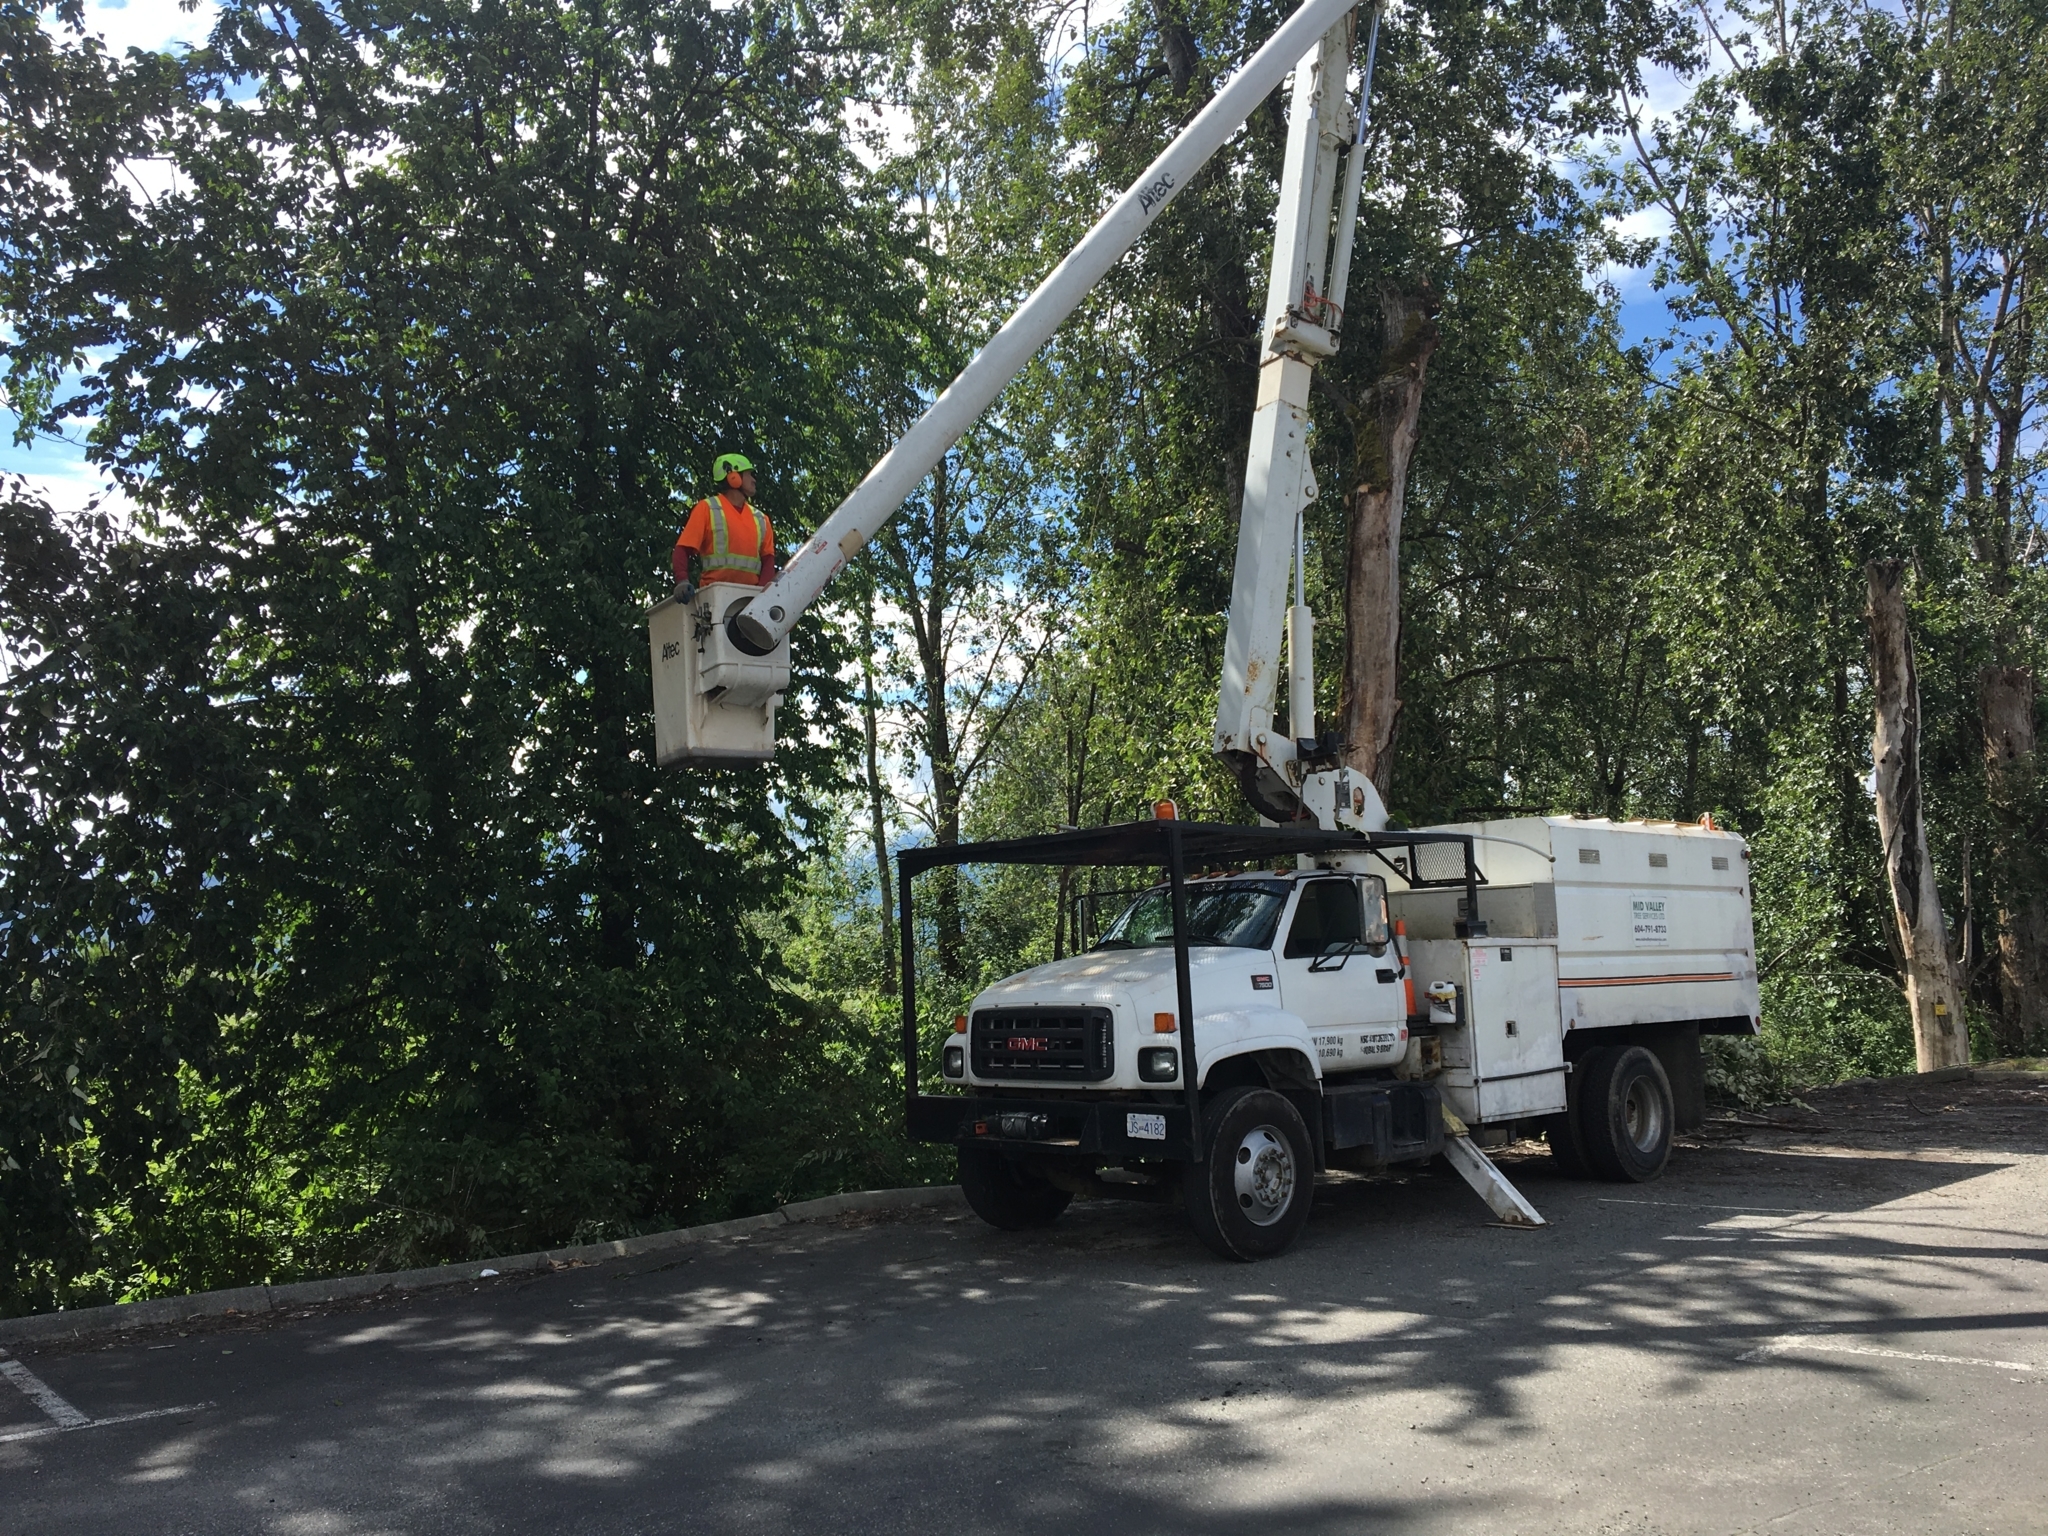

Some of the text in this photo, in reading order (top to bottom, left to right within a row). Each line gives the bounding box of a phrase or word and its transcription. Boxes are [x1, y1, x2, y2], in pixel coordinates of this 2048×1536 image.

[1138, 172, 1175, 216] Altec
[662, 641, 680, 662] Altec
[1633, 901, 1665, 911] MID VALLEY
[1007, 1037, 1048, 1051] GMC
[1337, 1035, 1343, 1046] kg
[1337, 1047, 1343, 1058] kg
